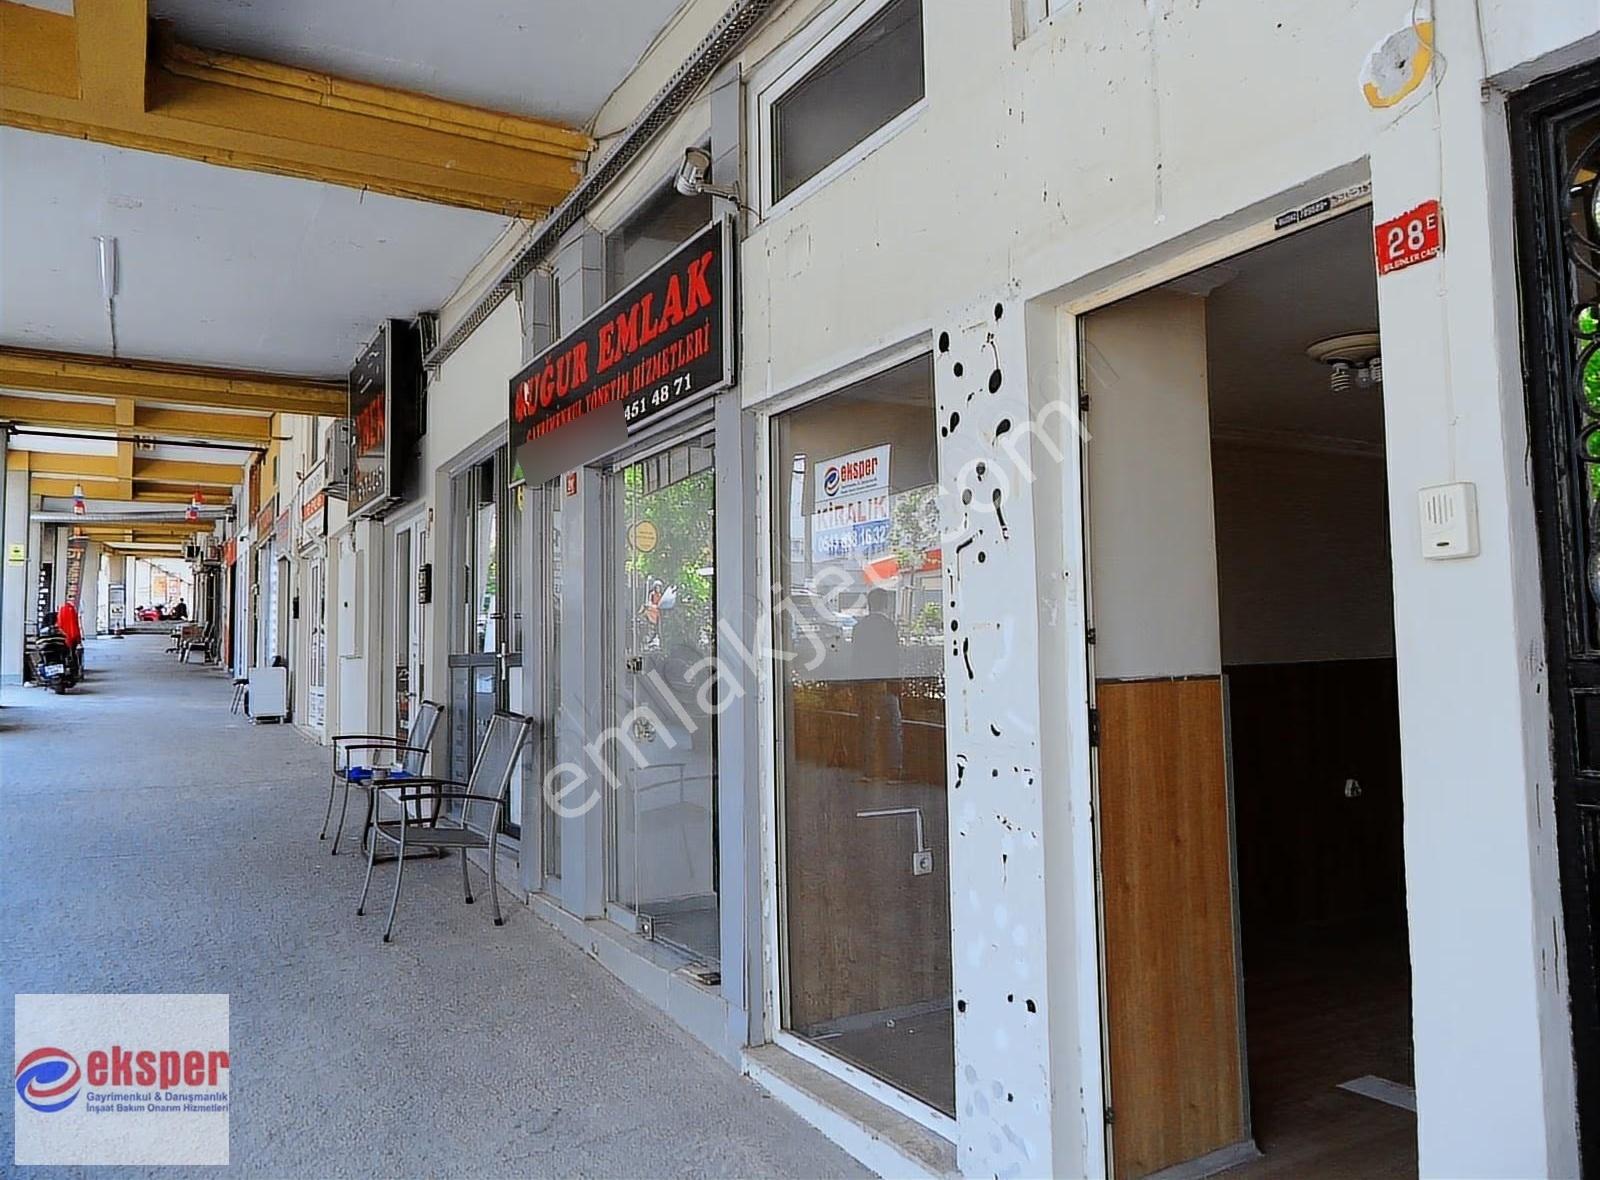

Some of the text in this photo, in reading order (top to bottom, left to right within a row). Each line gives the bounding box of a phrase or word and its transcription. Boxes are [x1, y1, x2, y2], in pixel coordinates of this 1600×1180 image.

[1387, 213, 1437, 260] 28 E
[597, 250, 713, 374] EMLAK
[651, 385, 669, 406] 48
[674, 373, 691, 395] 71
[840, 457, 878, 482] eksper
[816, 496, 887, 530] KİRALIK
